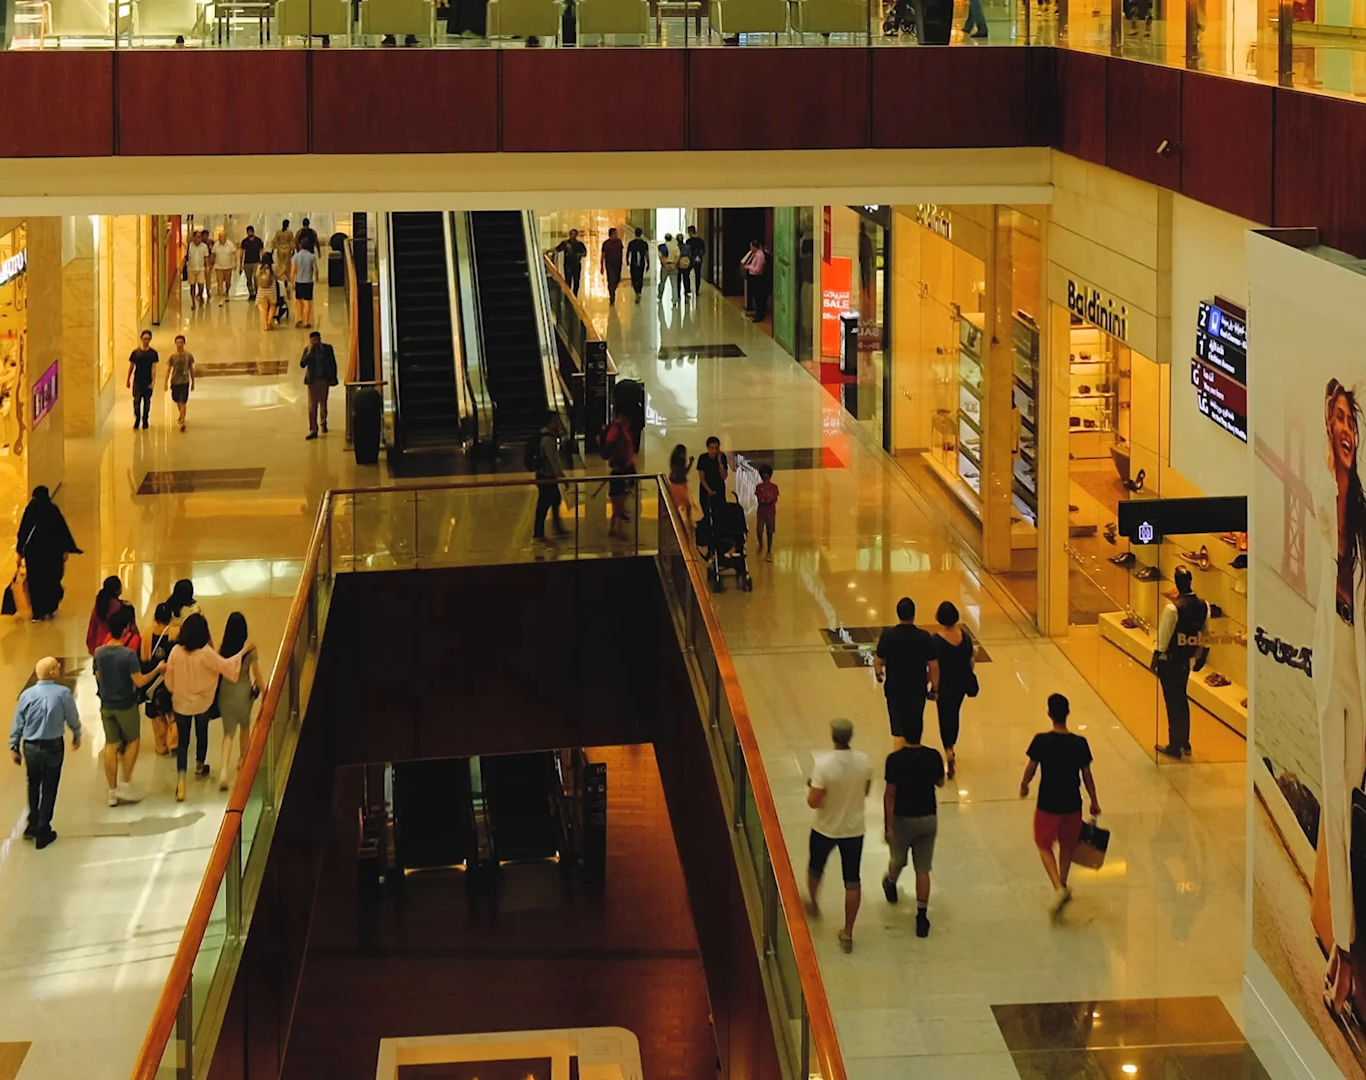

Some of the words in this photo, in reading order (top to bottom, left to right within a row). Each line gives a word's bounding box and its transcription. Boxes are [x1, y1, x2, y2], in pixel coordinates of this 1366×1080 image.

[822, 299, 850, 310] SALE
[1067, 279, 1129, 341] Baldinini
[1199, 310, 1207, 327] 2
[1199, 340, 1204, 356] 1
[1192, 369, 1200, 385] G
[1197, 395, 1209, 415] LG
